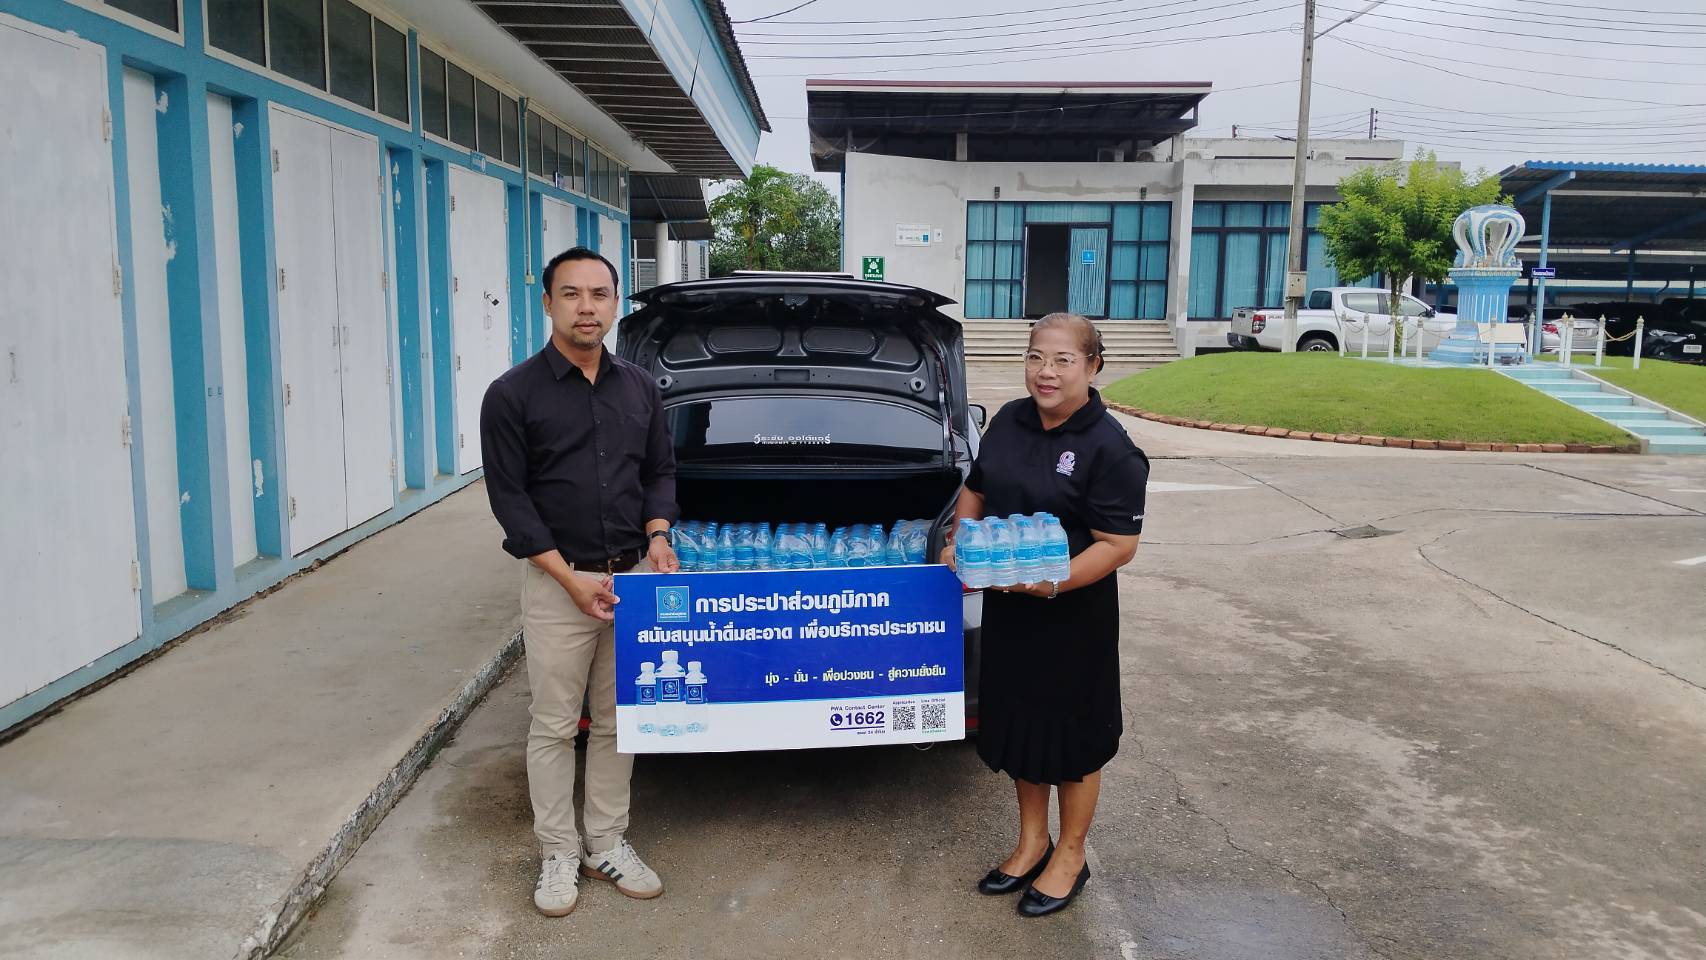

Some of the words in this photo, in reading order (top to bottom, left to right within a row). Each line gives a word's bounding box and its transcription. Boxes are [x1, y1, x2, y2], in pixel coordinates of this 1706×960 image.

[695, 590, 890, 614] การประปาส่วนภูมิภาค
[637, 621, 793, 646] สนับสนุนน้ำดื่มสะอาด
[800, 619, 946, 639] เพื่อบริการประชาชน
[765, 672, 780, 686] มุ่ง
[793, 669, 808, 683] มั่น
[822, 668, 874, 682] เพื่อปวงชน
[888, 664, 946, 682] สู่ความยั่งยืน
[845, 711, 885, 726] 1662
